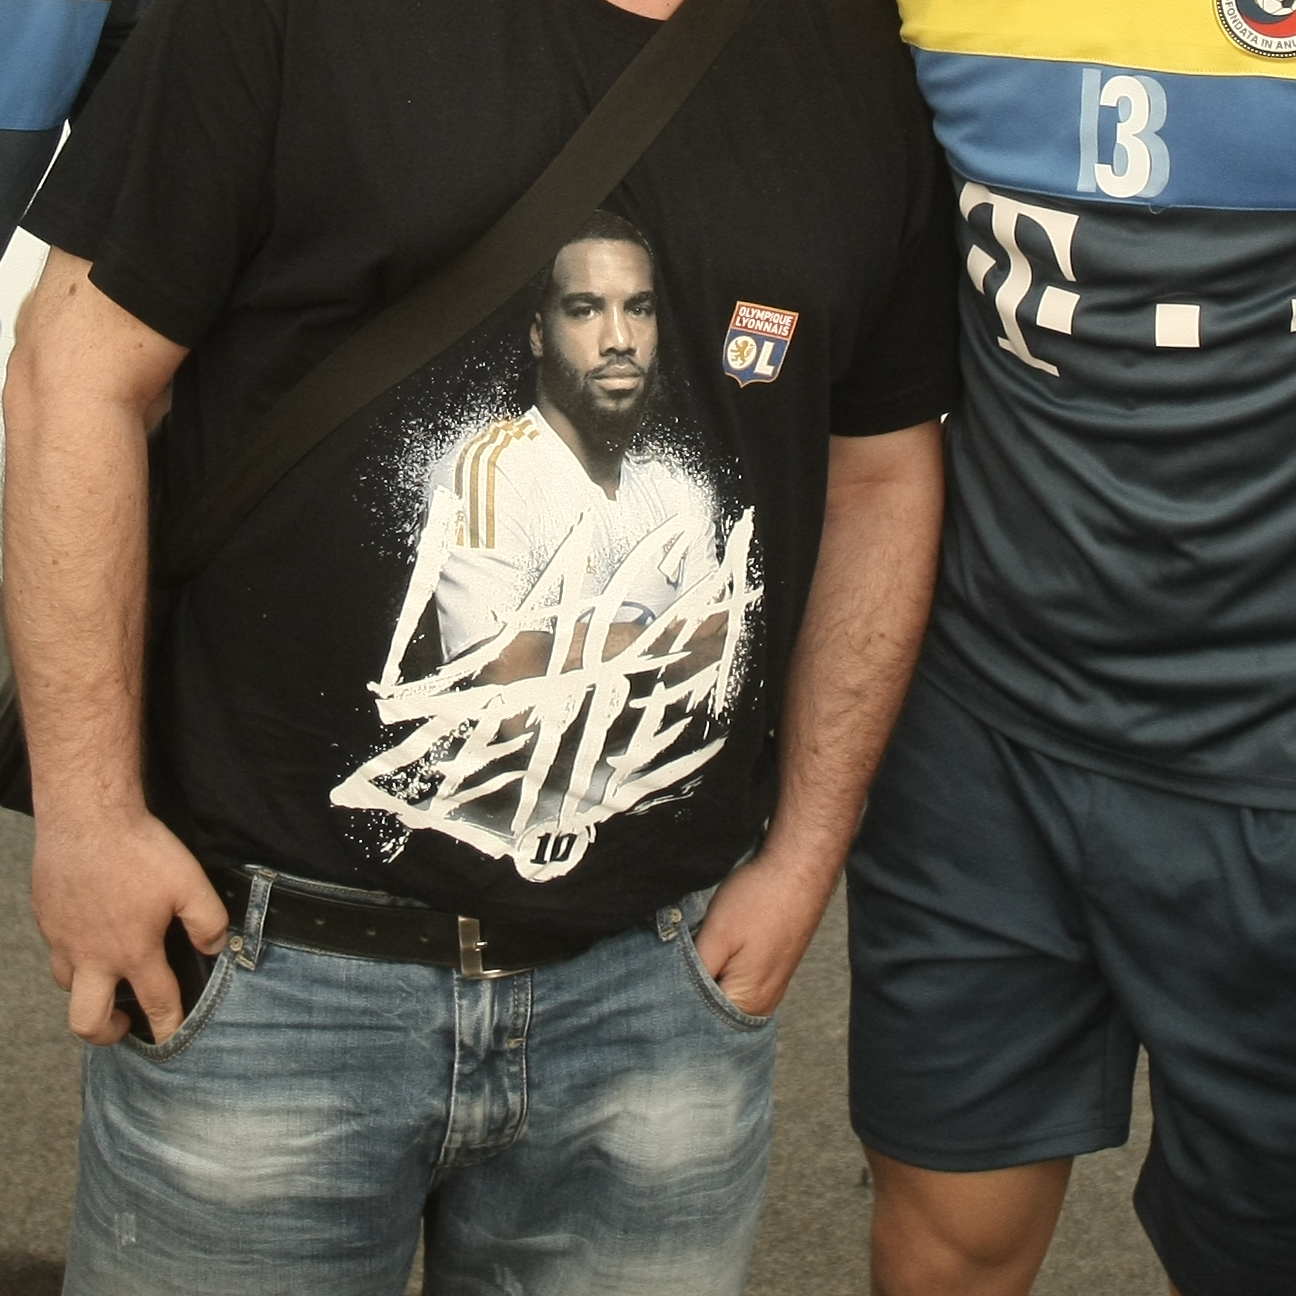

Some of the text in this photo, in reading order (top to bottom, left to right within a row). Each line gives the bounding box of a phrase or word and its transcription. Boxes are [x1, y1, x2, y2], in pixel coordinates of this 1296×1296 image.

[735, 315, 790, 337] LYONNAIS
[738, 306, 794, 327] OLYMPIQUE
[530, 832, 578, 865] 10
